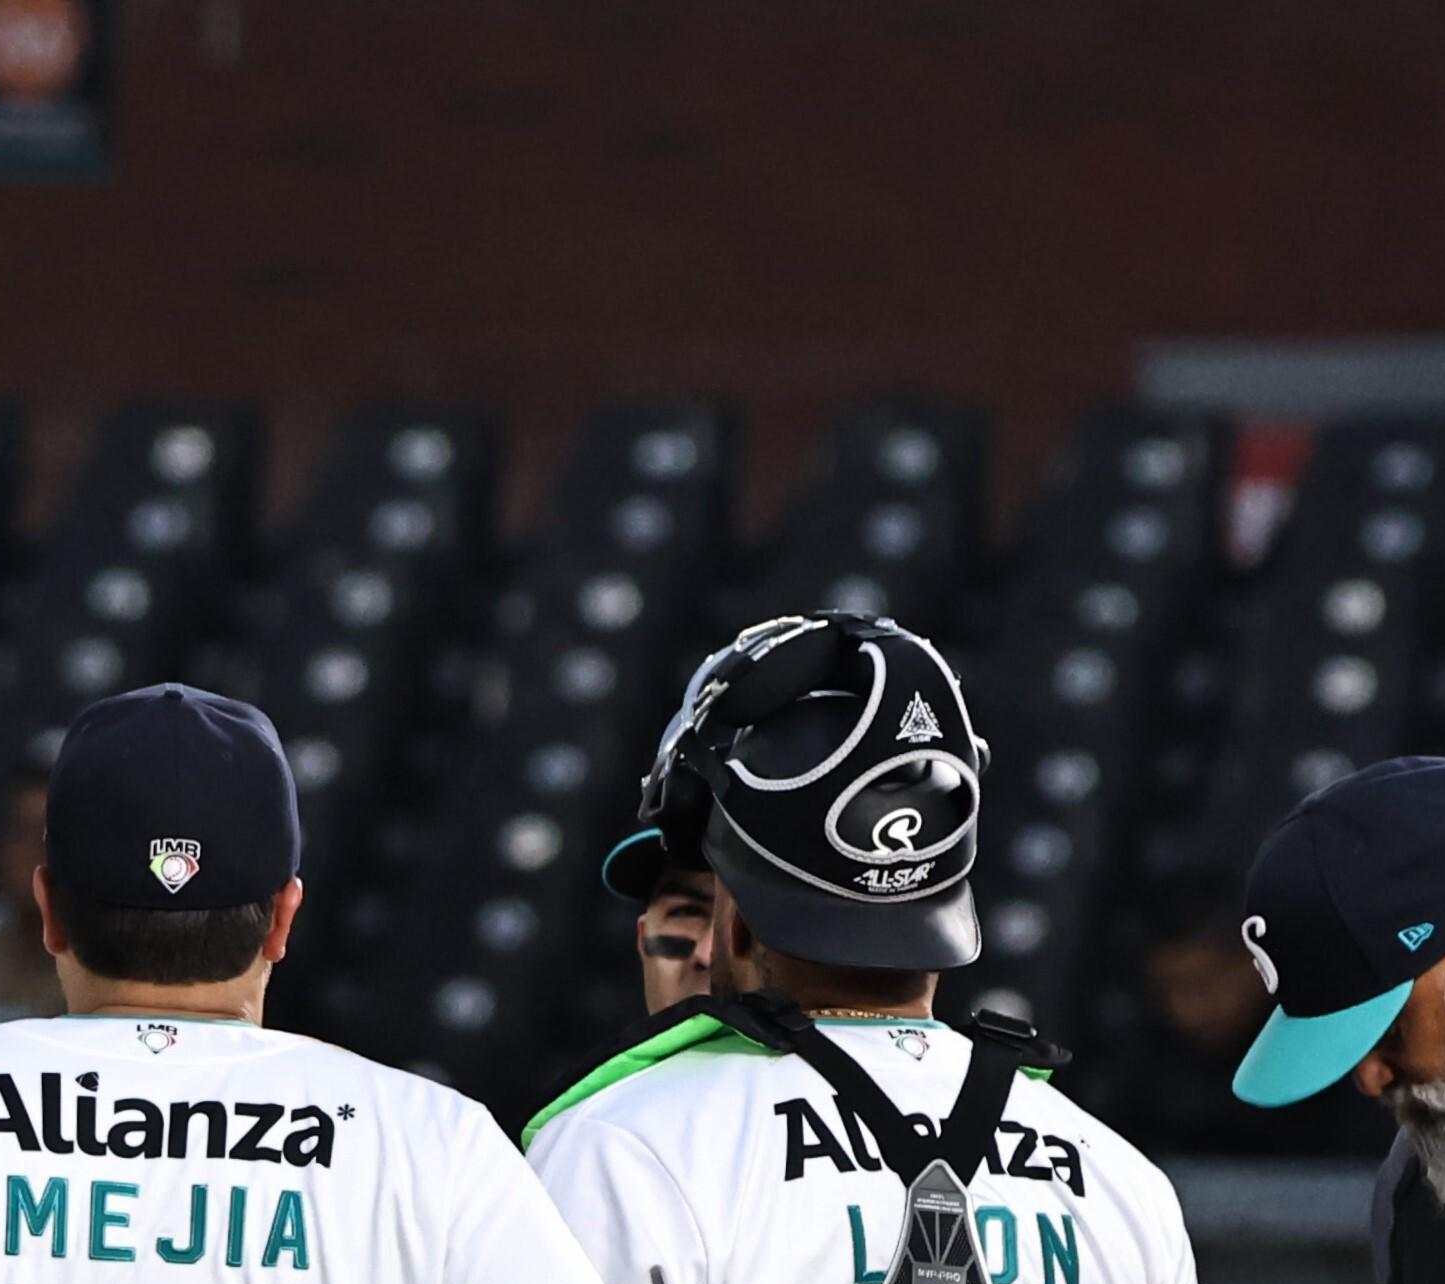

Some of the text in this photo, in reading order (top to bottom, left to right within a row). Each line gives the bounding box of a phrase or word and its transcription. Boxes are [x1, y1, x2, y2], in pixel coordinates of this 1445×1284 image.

[149, 838, 201, 860] LMB
[136, 1023, 178, 1036] LMB
[773, 1097, 1086, 1198] Alza
[4, 1174, 310, 1272] MEJIA
